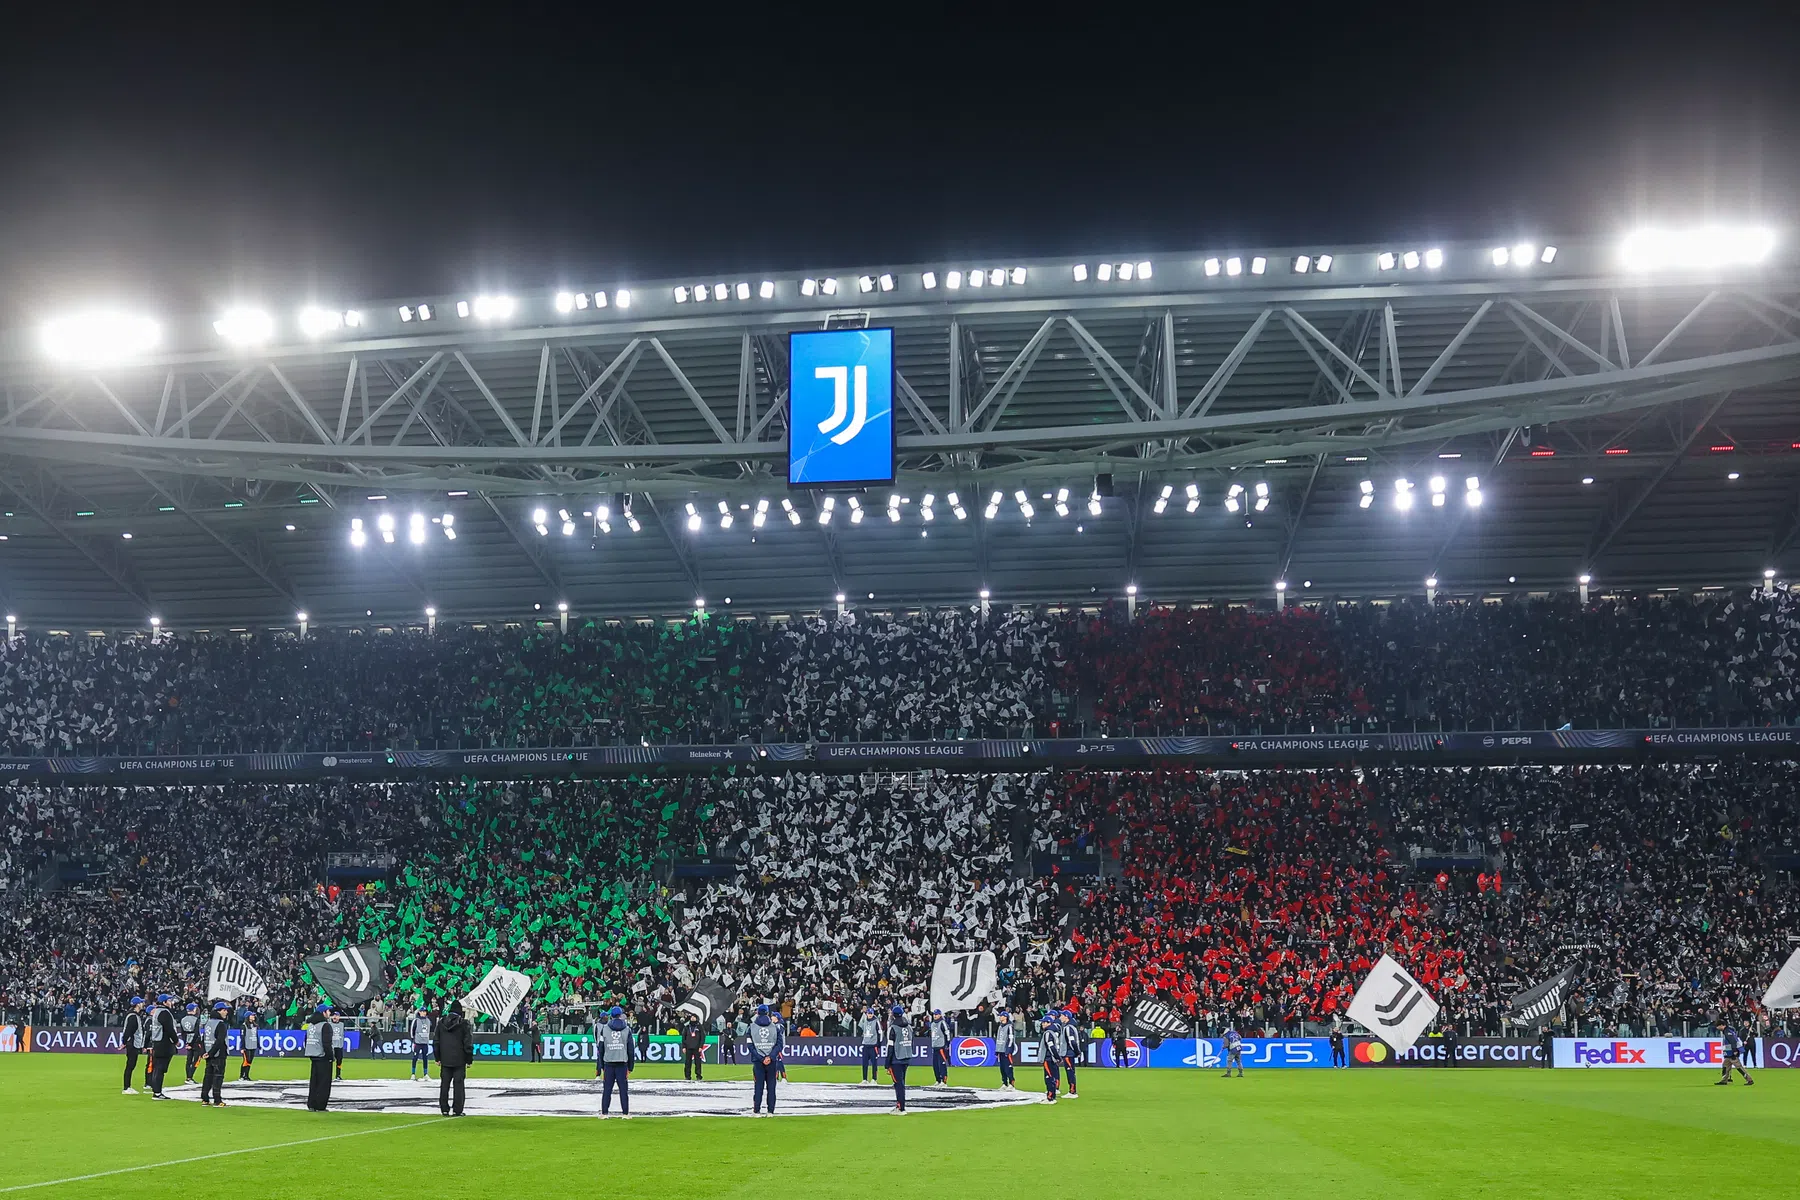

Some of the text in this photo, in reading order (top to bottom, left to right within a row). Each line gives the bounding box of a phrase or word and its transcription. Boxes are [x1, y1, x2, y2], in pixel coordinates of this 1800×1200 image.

[1501, 736, 1532, 746] PEPSI
[1649, 732, 1792, 743] EFA CHAMPIONS LEAGUE
[1090, 744, 1115, 752] PS5
[1234, 739, 1370, 750] EFA CHAMPIONS LEAGUE
[689, 750, 722, 759] Heineken
[830, 746, 964, 757] UEFA CHAMPIONS LEAGUE
[339, 756, 373, 765] mastercard
[463, 752, 588, 764] UEFA CHAMPIONS LEAUE
[119, 759, 235, 770] UEFA CHAMPIONS LEAUE
[1134, 1018, 1157, 1033] SINCE
[35, 1030, 98, 1050] QATAR
[959, 1048, 986, 1056] PEPSI
[1239, 1043, 1313, 1063] PS5
[1574, 1041, 1646, 1064] FedEx
[1667, 1041, 1723, 1065] FedE
